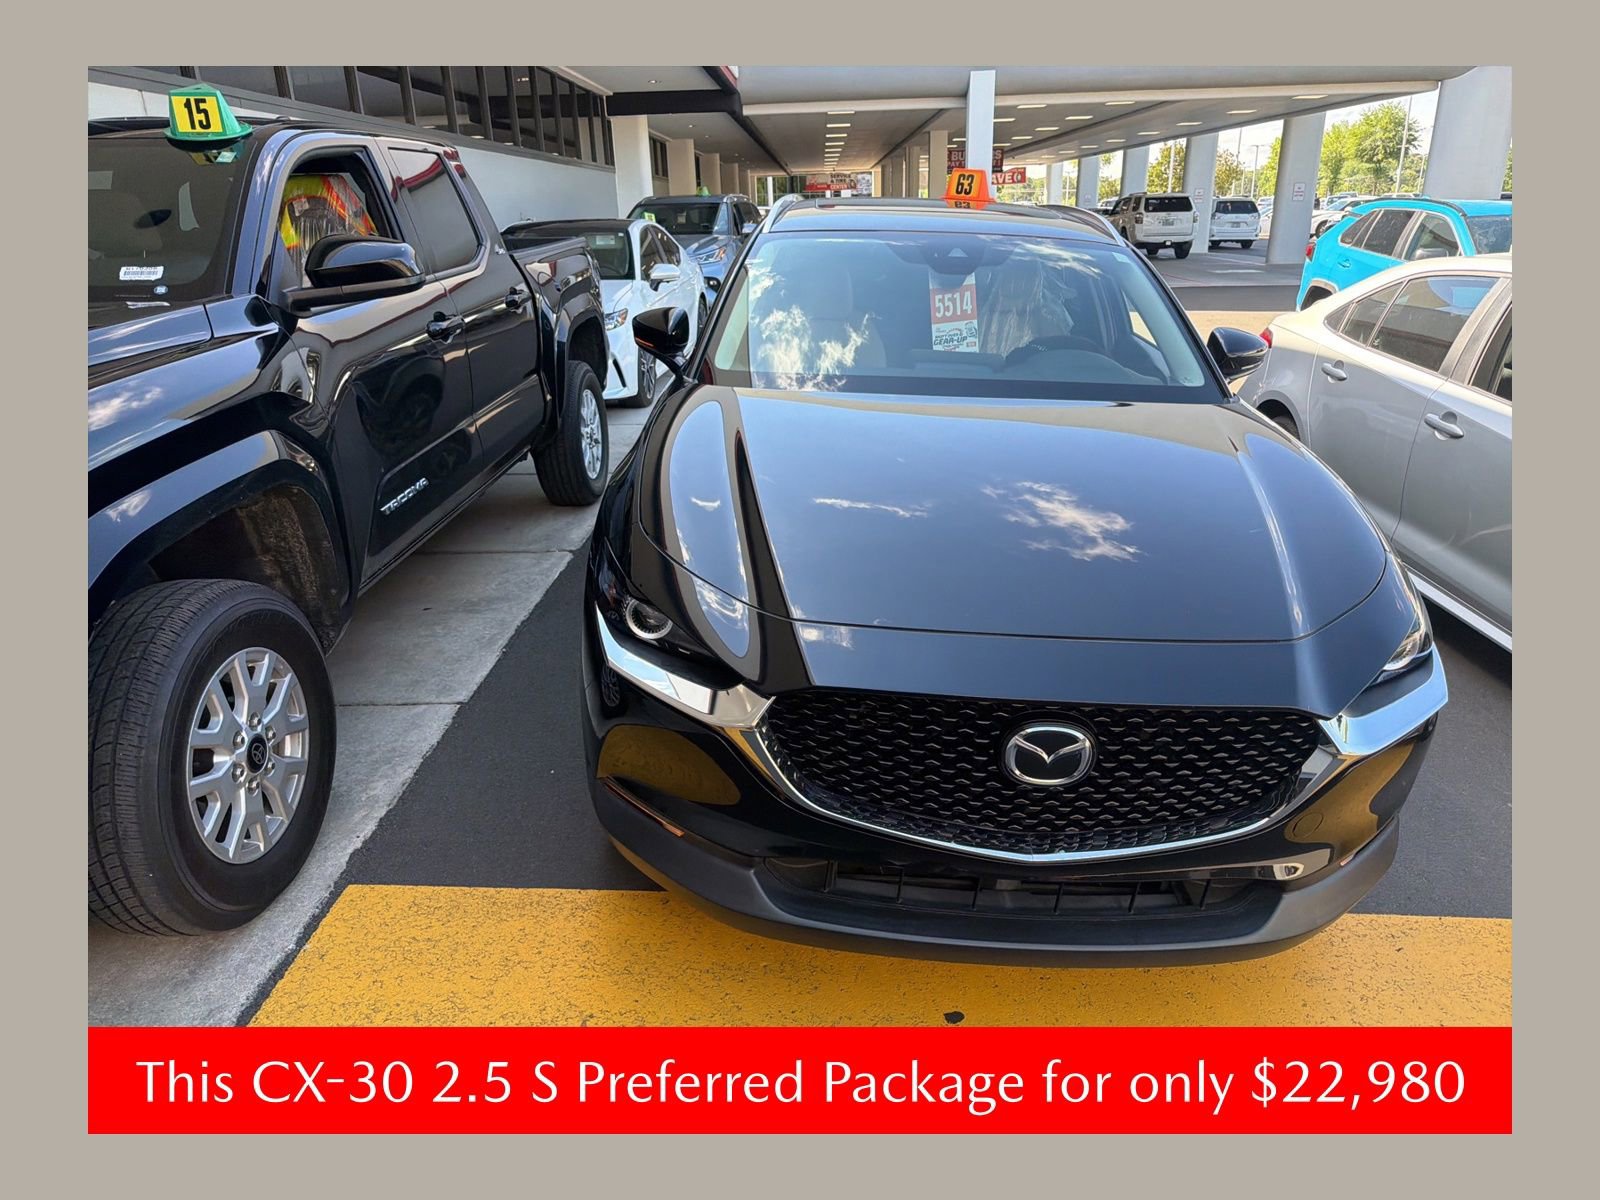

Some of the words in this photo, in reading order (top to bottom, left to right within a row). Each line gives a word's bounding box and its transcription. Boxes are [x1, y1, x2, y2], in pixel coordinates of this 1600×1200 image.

[184, 98, 211, 130] 15
[951, 151, 965, 160] BU
[955, 173, 975, 195] 63
[935, 291, 972, 318] 5514
[933, 336, 968, 346] GEAR-UP
[380, 477, 429, 515] TACOMA
